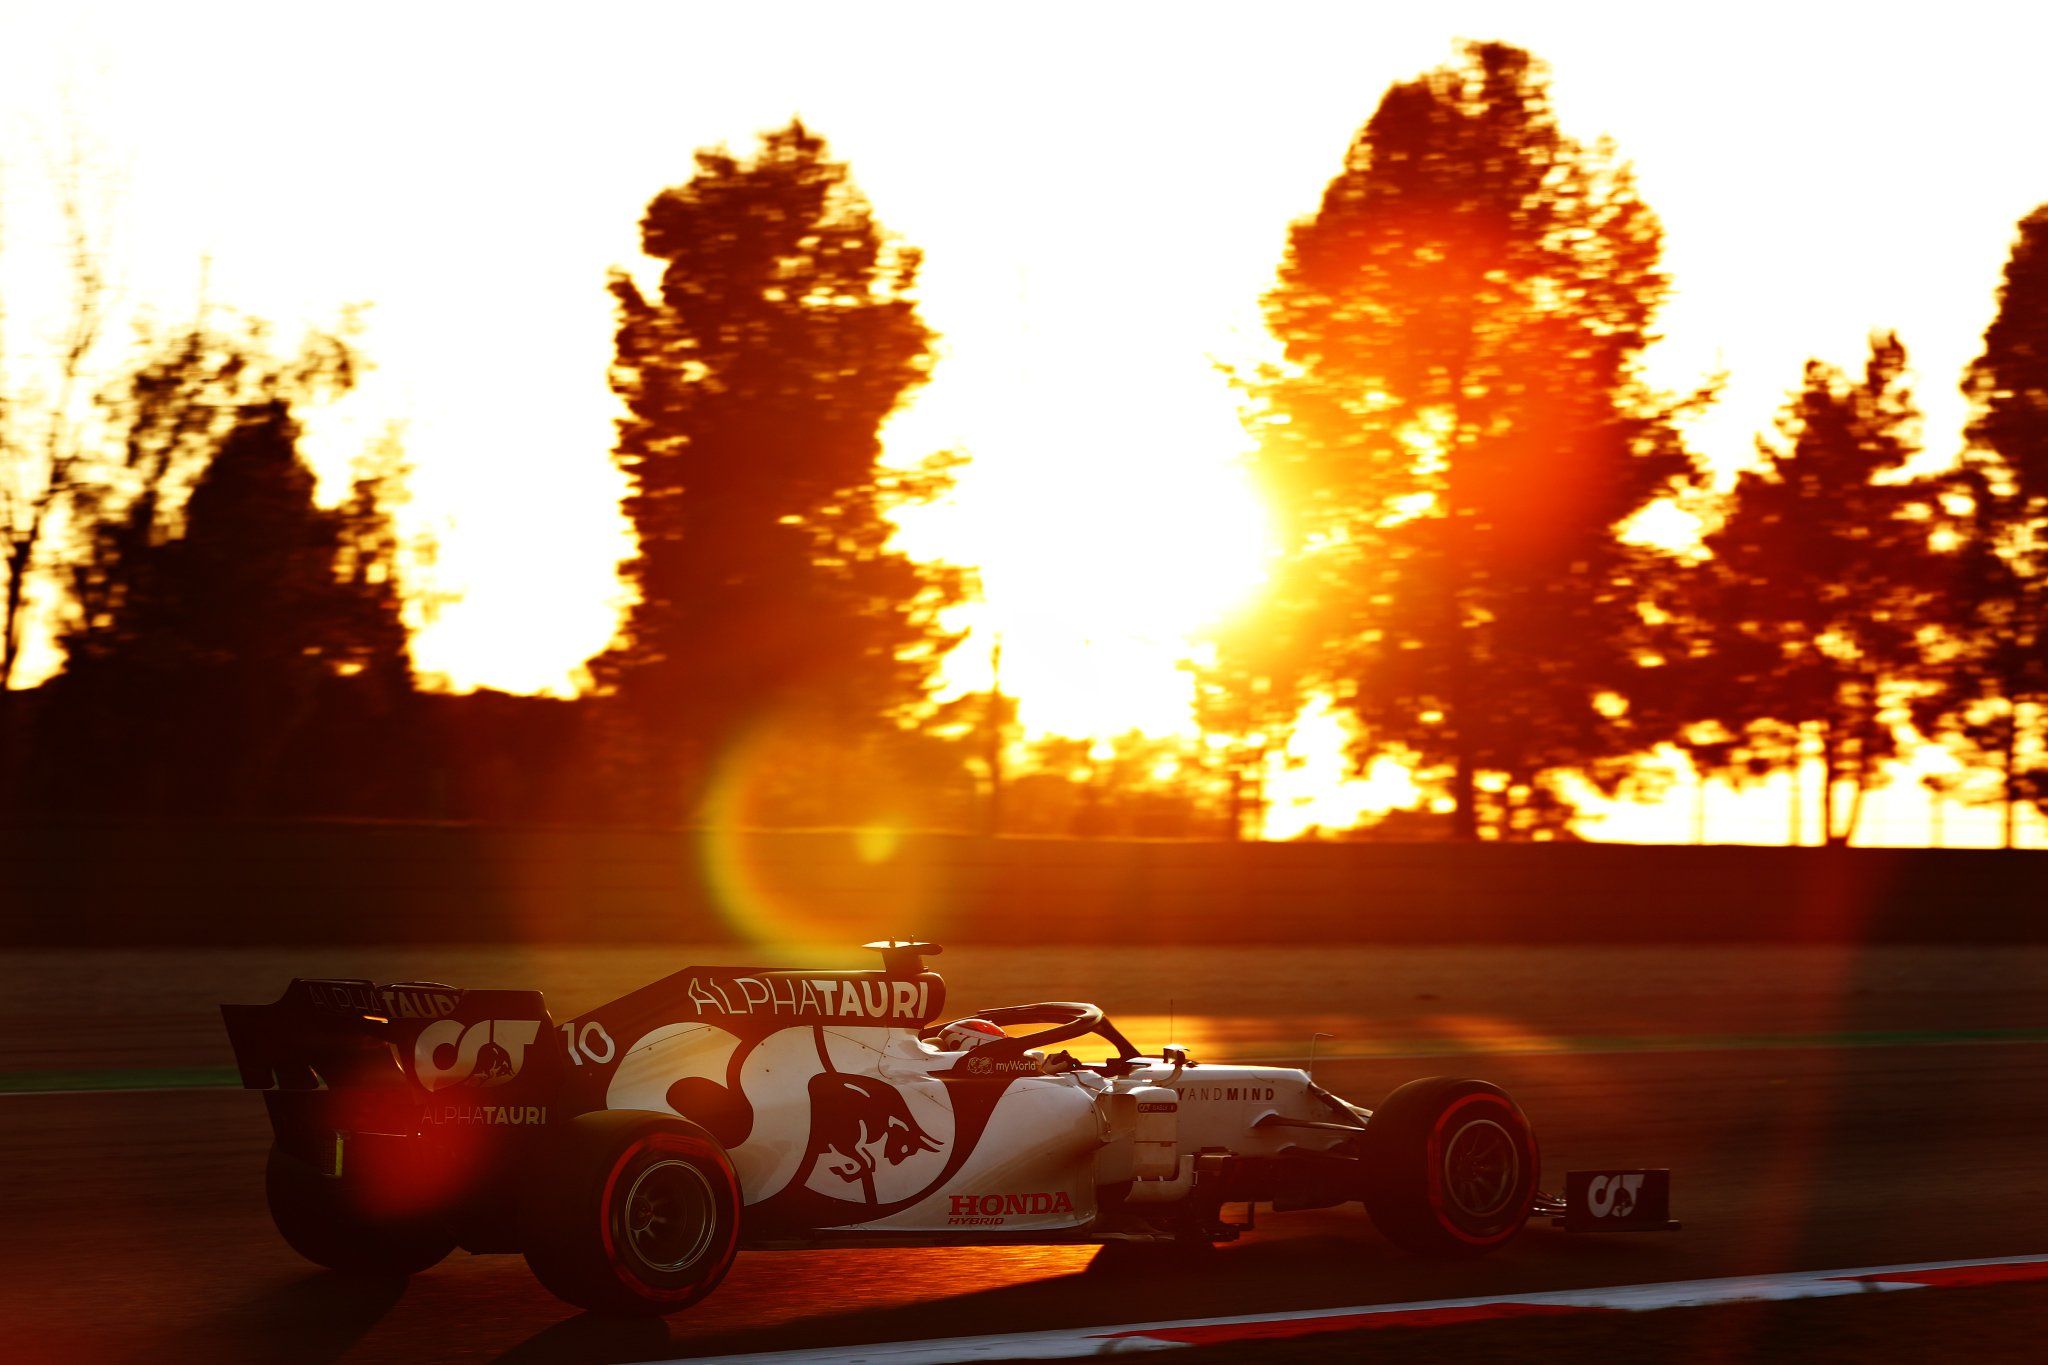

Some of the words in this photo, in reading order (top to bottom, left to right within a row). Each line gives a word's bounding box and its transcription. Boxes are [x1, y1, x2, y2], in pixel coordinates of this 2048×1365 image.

[688, 977, 929, 1019] ALPHATAURI
[561, 1021, 616, 1066] 10
[996, 1060, 1036, 1072] myWorld
[421, 1107, 547, 1125] ALPHATAURI
[948, 1191, 1075, 1216] HONDA
[947, 1217, 1005, 1225] HYBRID
